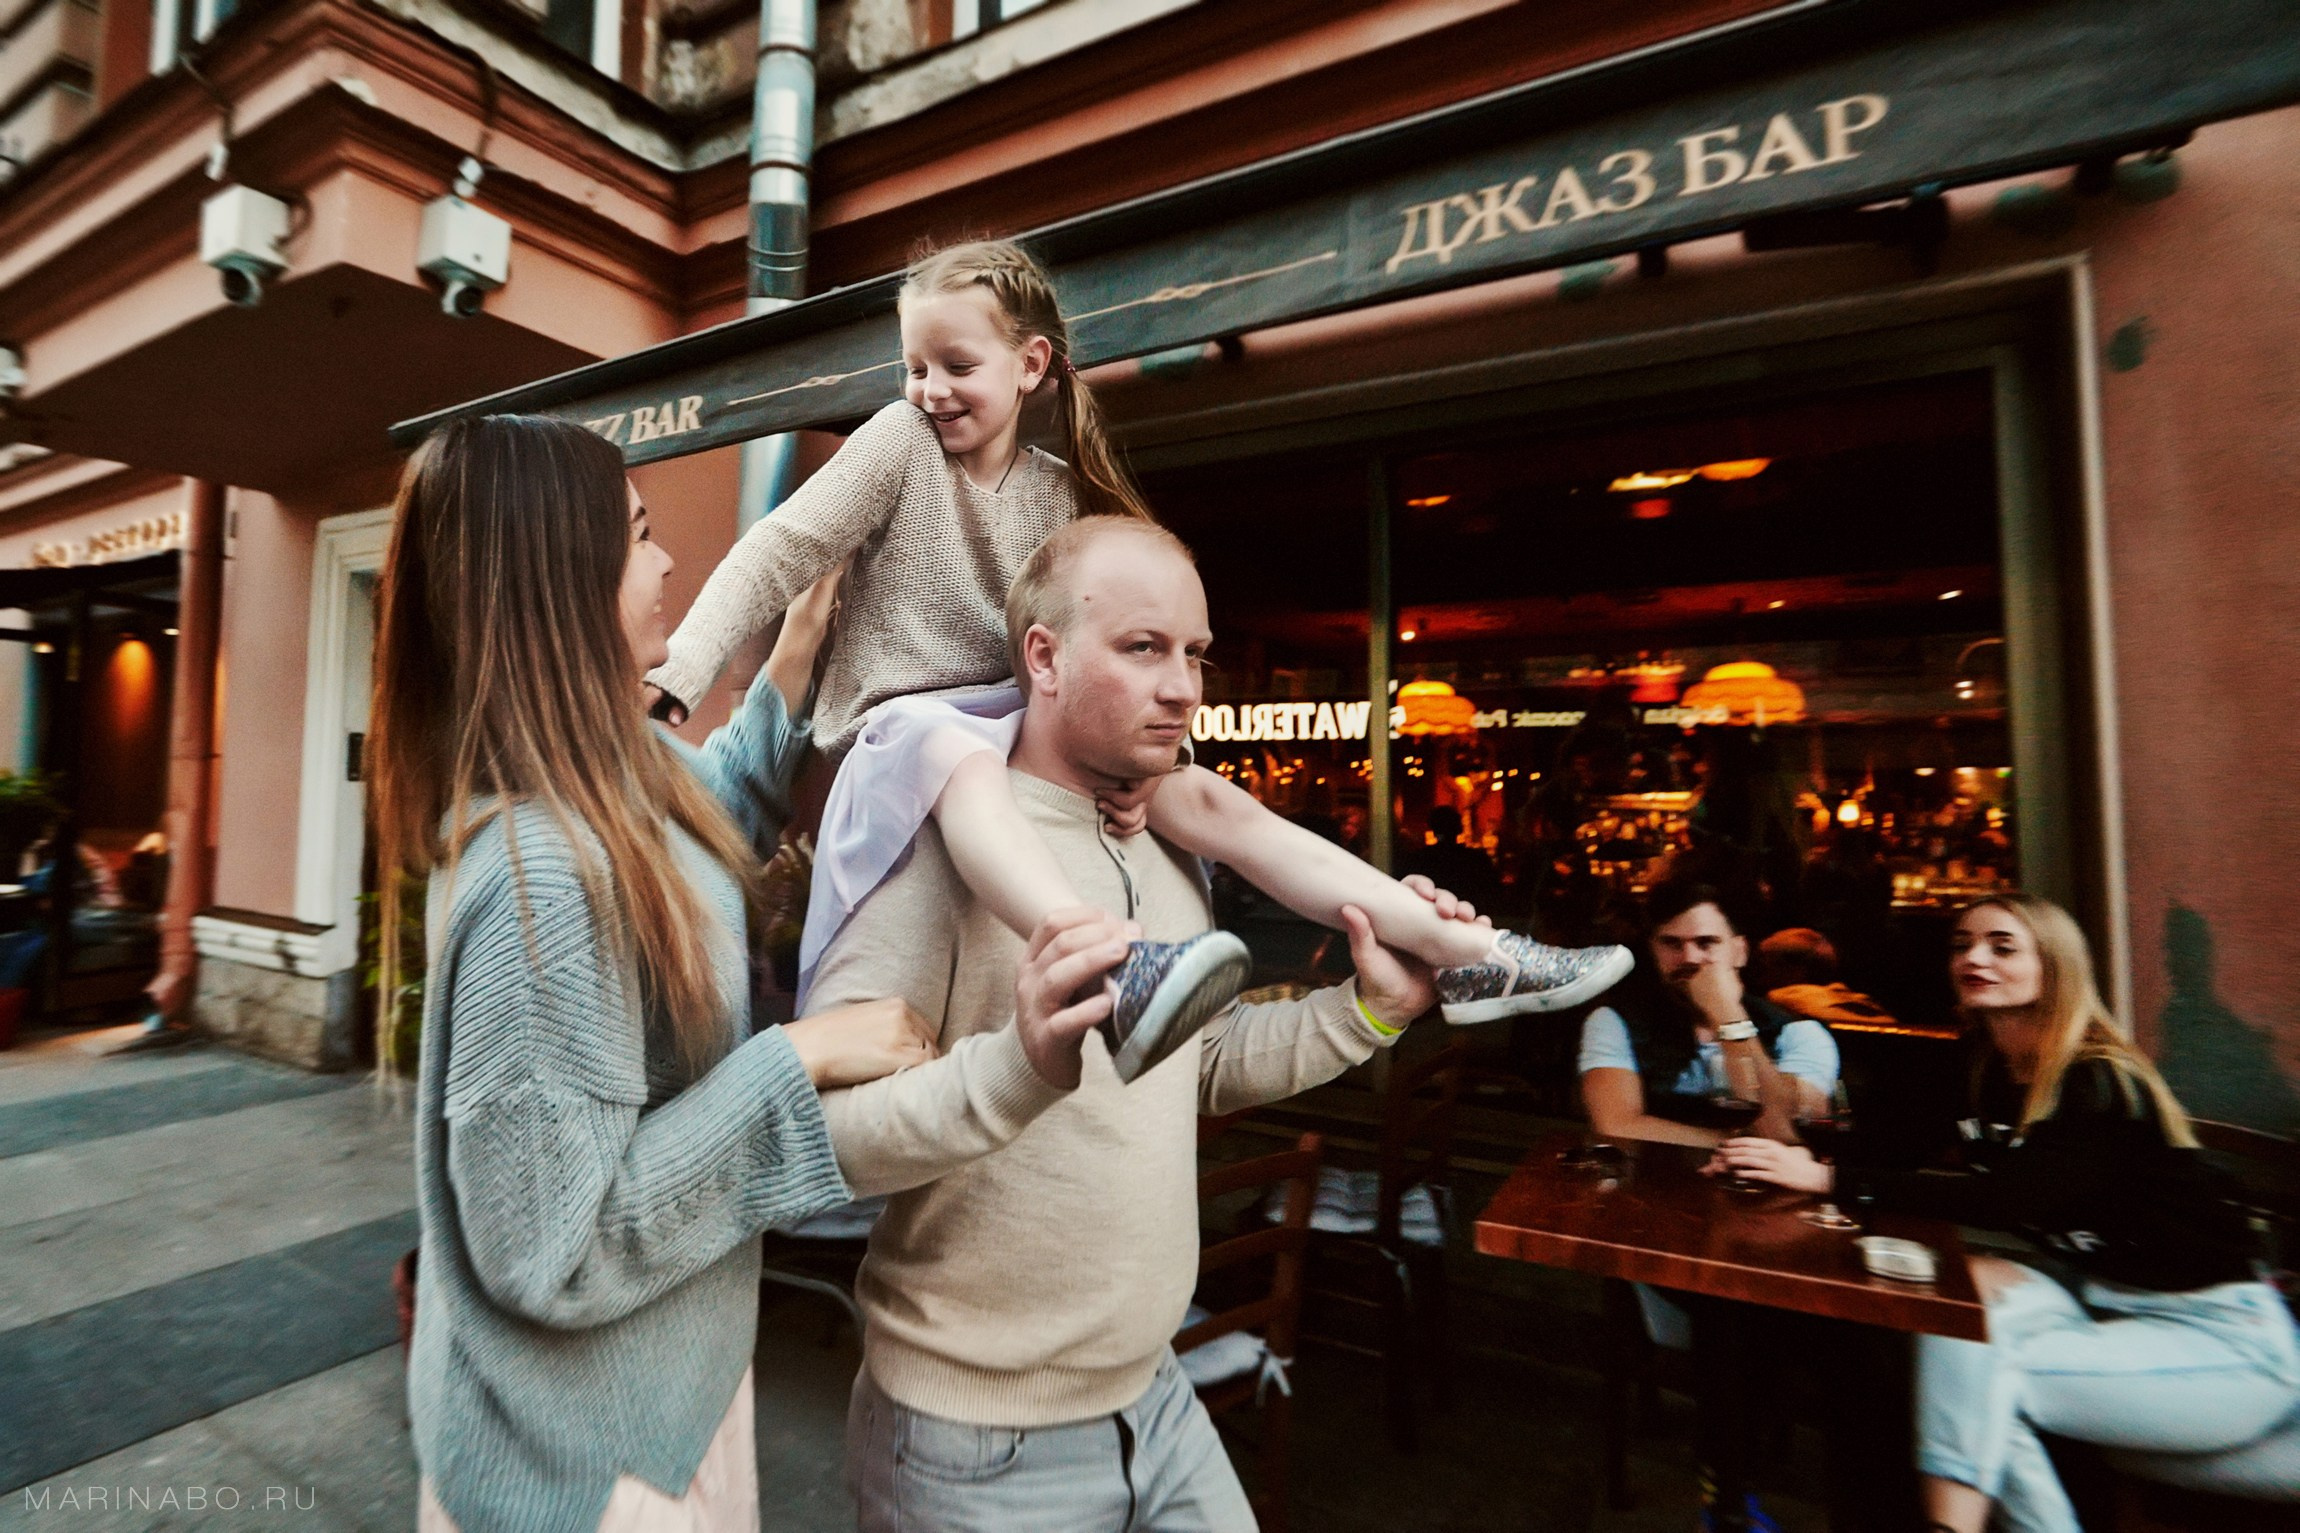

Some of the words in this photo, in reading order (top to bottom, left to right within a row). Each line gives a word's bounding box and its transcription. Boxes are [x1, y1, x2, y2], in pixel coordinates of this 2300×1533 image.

[1385, 149, 1657, 275] ДЖАЗ
[1676, 93, 1888, 197] БАР
[626, 395, 704, 446] BAR
